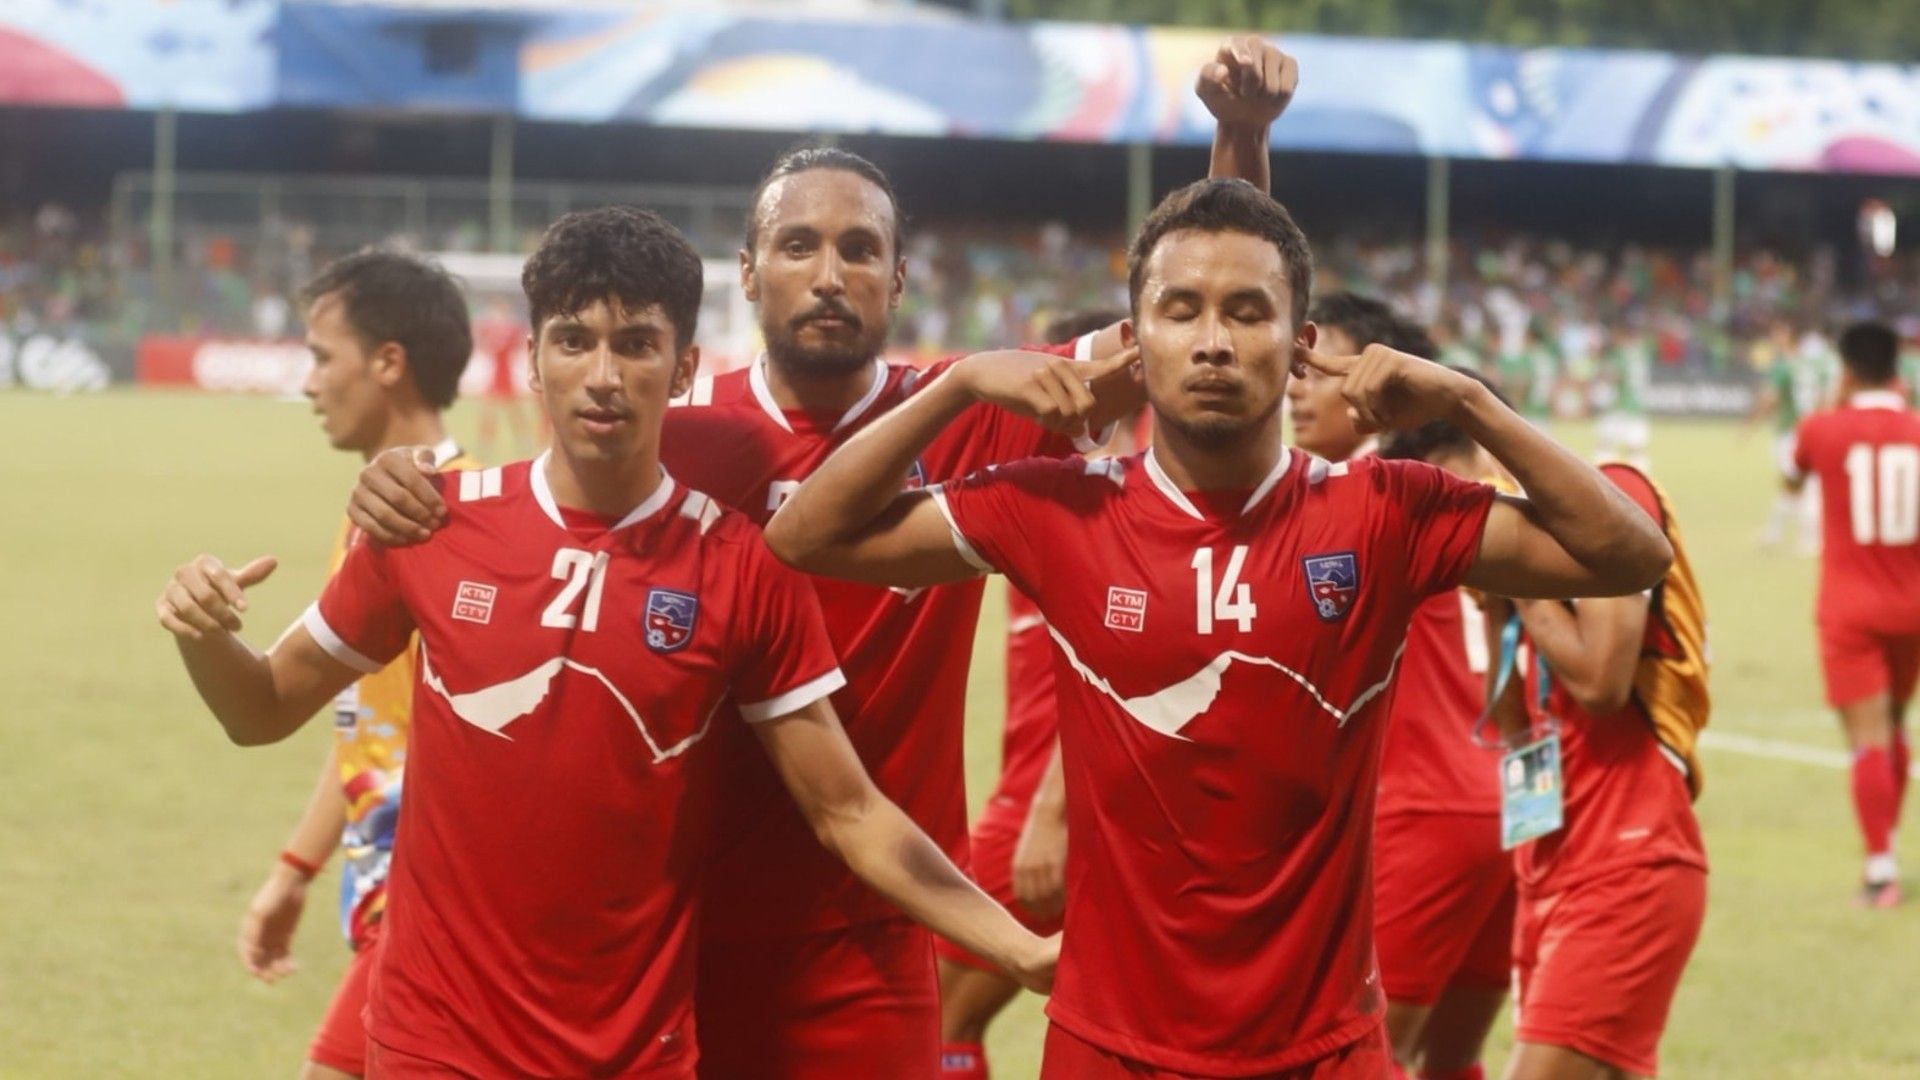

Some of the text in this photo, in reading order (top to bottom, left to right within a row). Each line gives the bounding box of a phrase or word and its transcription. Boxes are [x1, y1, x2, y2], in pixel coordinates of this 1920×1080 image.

[1844, 442, 1919, 546] 10
[460, 587, 492, 601] KTM
[540, 547, 610, 632] 21
[1191, 545, 1257, 635] 14
[1112, 592, 1142, 607] KTM
[457, 603, 487, 617] CTY
[1110, 612, 1139, 626] CTY
